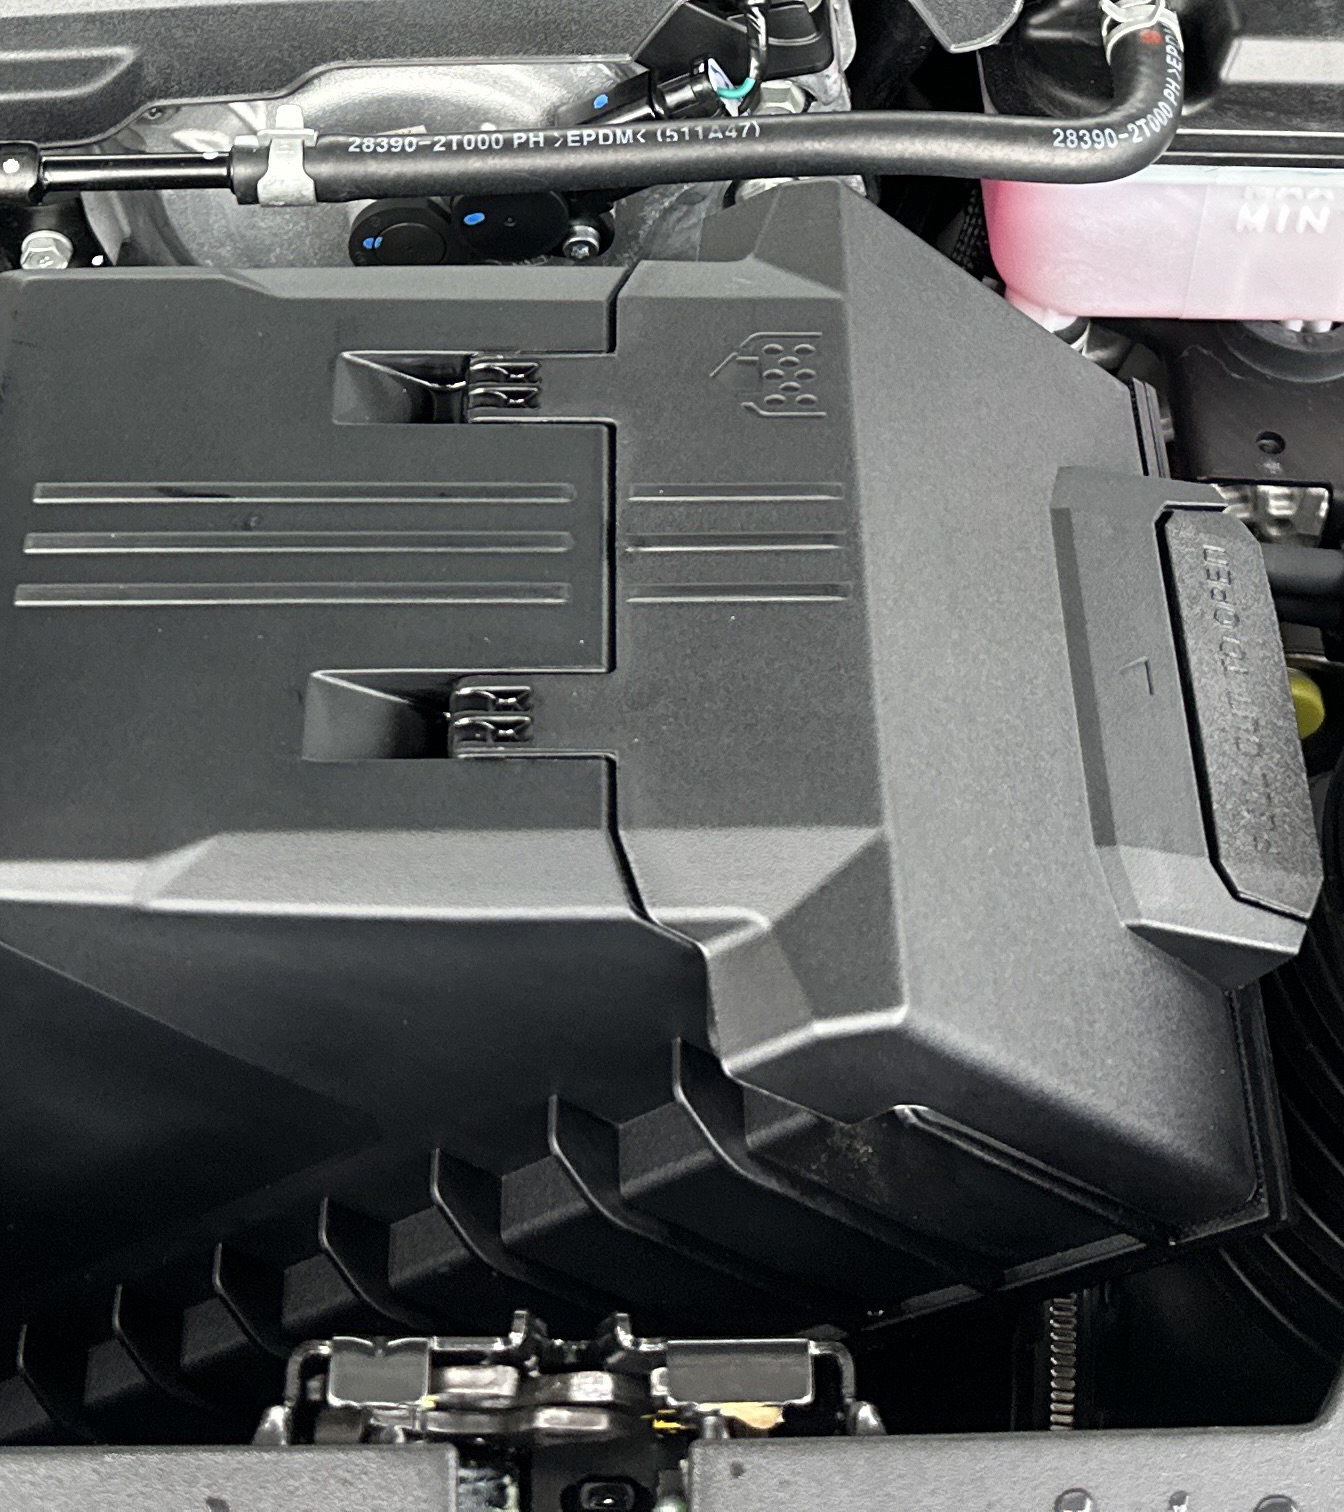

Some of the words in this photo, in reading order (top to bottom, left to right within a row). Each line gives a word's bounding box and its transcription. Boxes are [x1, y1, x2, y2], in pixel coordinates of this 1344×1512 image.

[1052, 101, 1173, 149] 28390-2T000
[1163, 77, 1181, 106] PH
[347, 132, 504, 153] 28390-2T000
[512, 132, 545, 149] PH
[1235, 202, 1330, 235] MIN
[1202, 544, 1242, 629] OPEN
